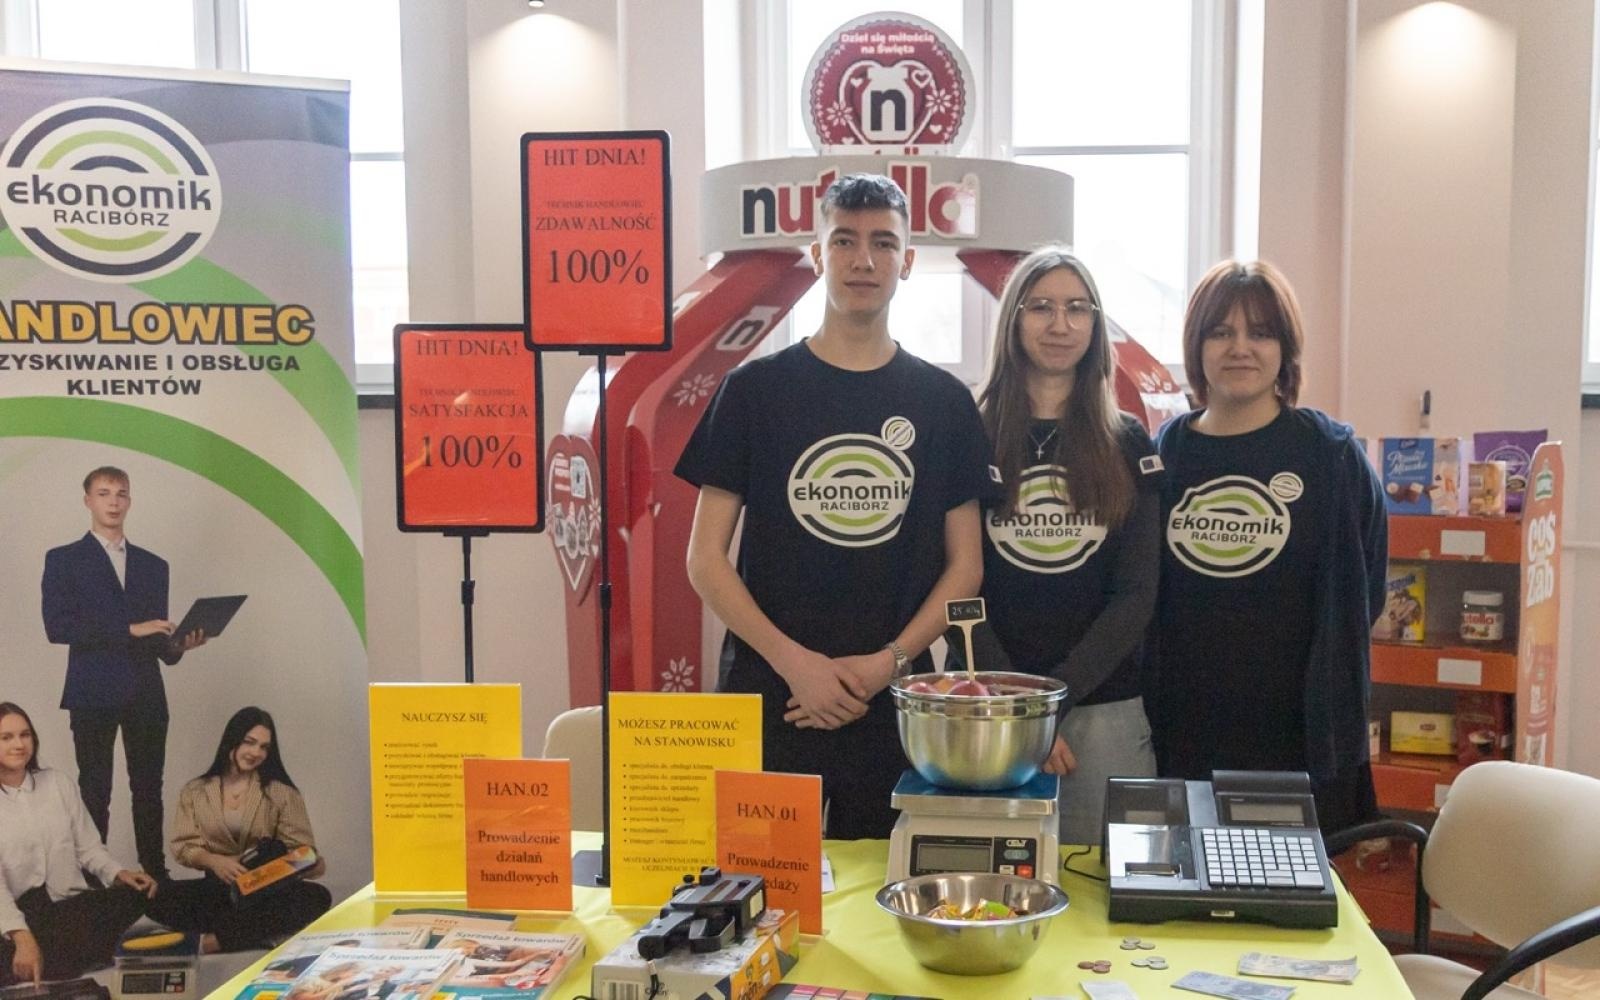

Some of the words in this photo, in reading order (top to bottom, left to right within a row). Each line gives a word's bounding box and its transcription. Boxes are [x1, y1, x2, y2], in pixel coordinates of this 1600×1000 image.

[870, 88, 906, 131] n
[543, 149, 578, 166] HIT
[585, 148, 646, 166] DNIA!
[6, 175, 212, 211] ekonomik
[53, 208, 170, 227] RACIBÓRZ
[535, 213, 655, 231] ZDAWALNOŚĆ
[550, 248, 650, 285] 100%
[415, 340, 451, 356] HIT
[459, 339, 520, 356] DNIA!
[166, 355, 173, 370] I
[183, 354, 301, 372] OBSŁUGA
[66, 376, 202, 395] KLIENTÓW
[409, 403, 529, 418] SATYSFAKCJA
[422, 434, 522, 469] 100%
[793, 481, 910, 500] ekonomik
[820, 500, 889, 511] RACIBÓRZ
[1014, 527, 1082, 537] RACIBÓRZ
[1171, 514, 1284, 535] ekonomik
[1190, 531, 1257, 544] RACIBÓRZ
[401, 712, 466, 722] NAUCZYSZ
[469, 712, 488, 724] SIĘ
[617, 718, 666, 730] MOŻESZ
[670, 717, 740, 731] PRACOWAĆ
[634, 737, 651, 747] NA
[654, 736, 736, 748] STANOWISKU
[487, 782, 549, 797] HAN.02
[737, 802, 797, 822] HAN.01
[477, 829, 561, 844] Prowadzenie
[495, 850, 543, 863] działań
[727, 851, 810, 871] Prowadzenie
[479, 869, 560, 887] handlowych
